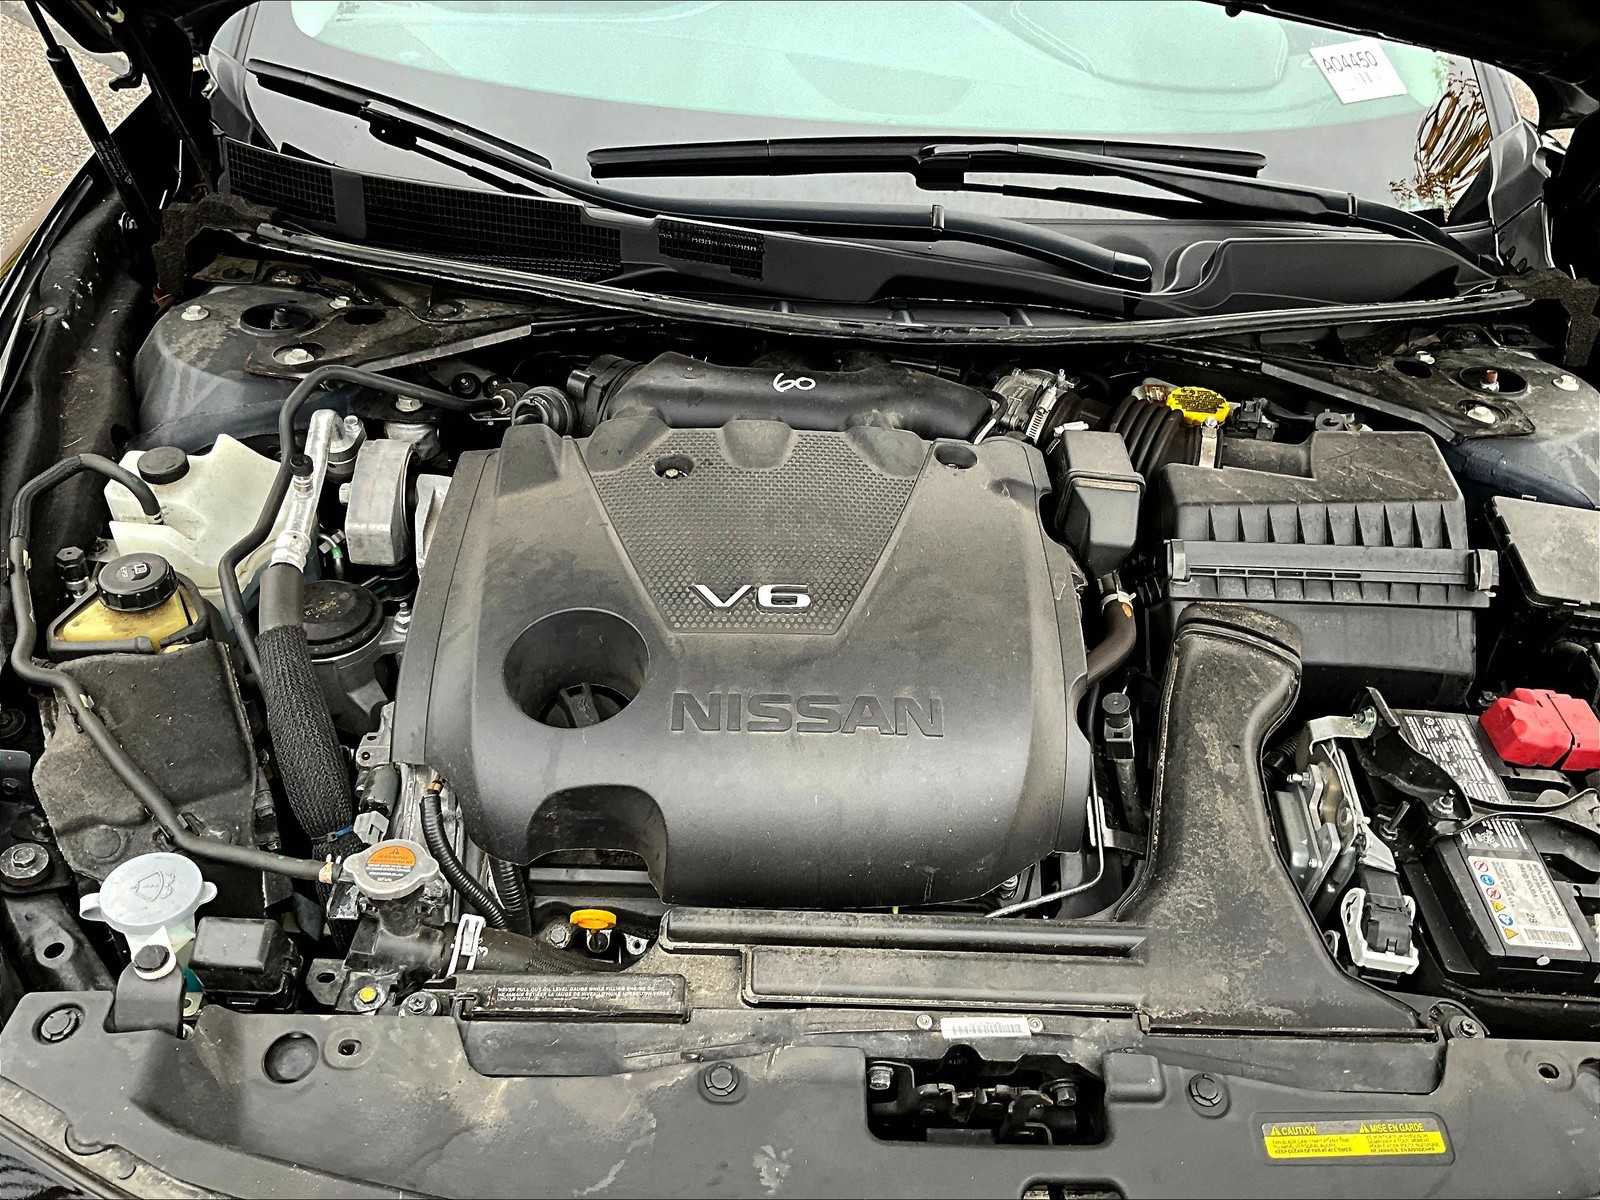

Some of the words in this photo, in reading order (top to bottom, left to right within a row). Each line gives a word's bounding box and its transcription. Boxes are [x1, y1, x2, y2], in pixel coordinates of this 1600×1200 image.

[772, 372, 816, 392] 60
[688, 584, 812, 614] V6
[671, 692, 944, 738] NISSAN
[1281, 1125, 1317, 1136] CAUTION
[1370, 1122, 1388, 1133] MISE
[1388, 1123, 1399, 1132] EN
[1399, 1121, 1425, 1132] GARDE
